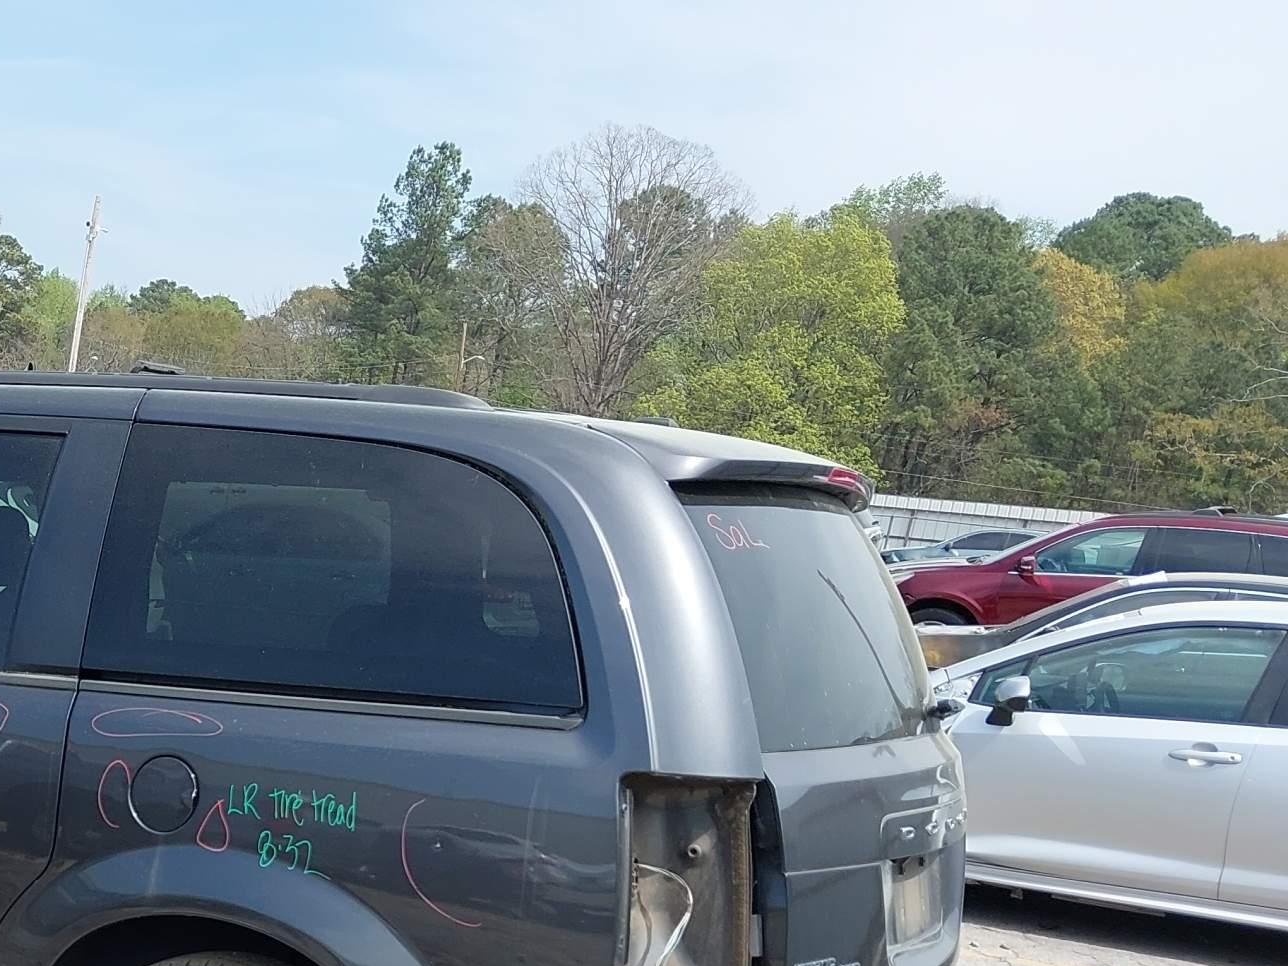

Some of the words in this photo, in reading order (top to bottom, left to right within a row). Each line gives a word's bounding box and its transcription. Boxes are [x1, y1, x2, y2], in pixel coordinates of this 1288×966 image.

[228, 783, 261, 820] LR
[268, 788, 304, 826] tire
[311, 789, 356, 832] tread
